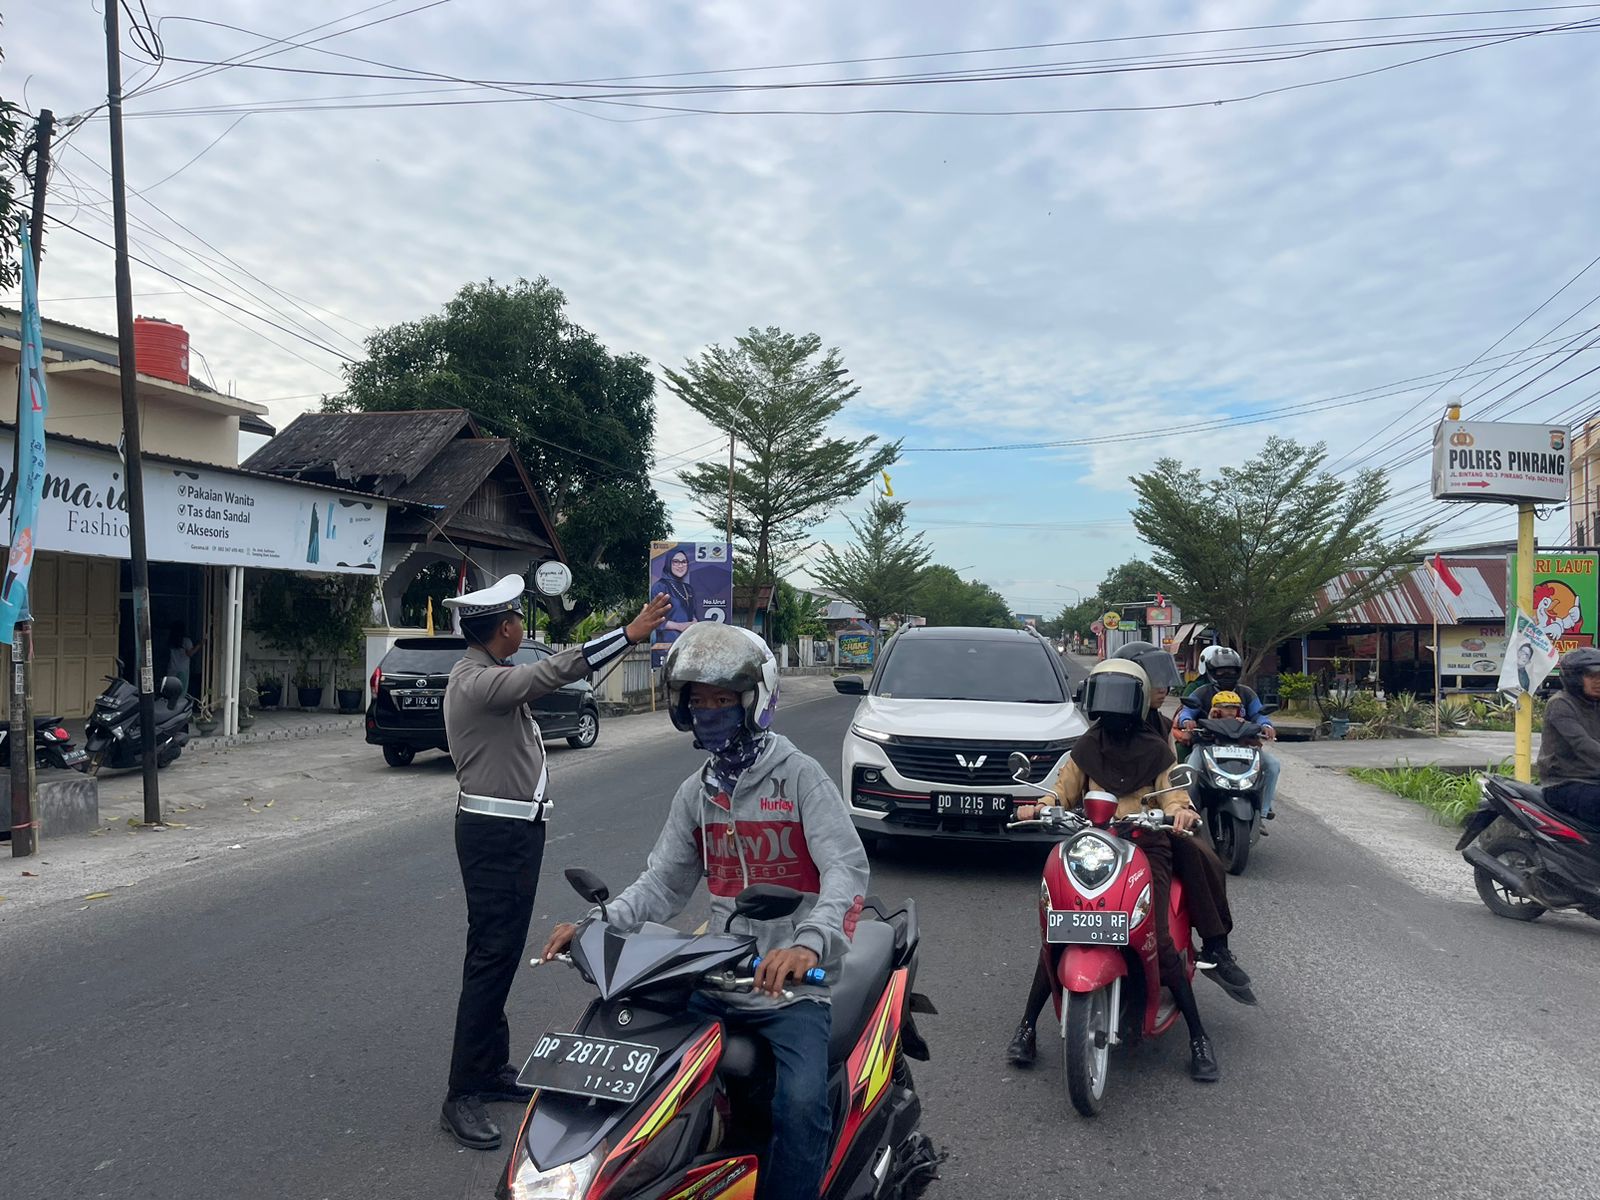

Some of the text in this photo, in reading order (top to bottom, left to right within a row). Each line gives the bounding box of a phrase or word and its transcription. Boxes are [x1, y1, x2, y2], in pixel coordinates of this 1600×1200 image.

[1449, 449, 1565, 476] POLRES PINRANG
[187, 485, 255, 507] Pakaian Wanita
[187, 504, 251, 524] Tas dan Sandal
[67, 510, 130, 538] Fashio
[186, 523, 229, 539] Aksesoris
[697, 547, 707, 559] 5
[1535, 559, 1593, 574] RI LAUT
[760, 798, 794, 812] Hurley
[938, 795, 1006, 810] DD 1215 RC
[1049, 914, 1126, 928] DP 5209 RF
[533, 1037, 561, 1058] DP
[565, 1041, 617, 1067] 2871
